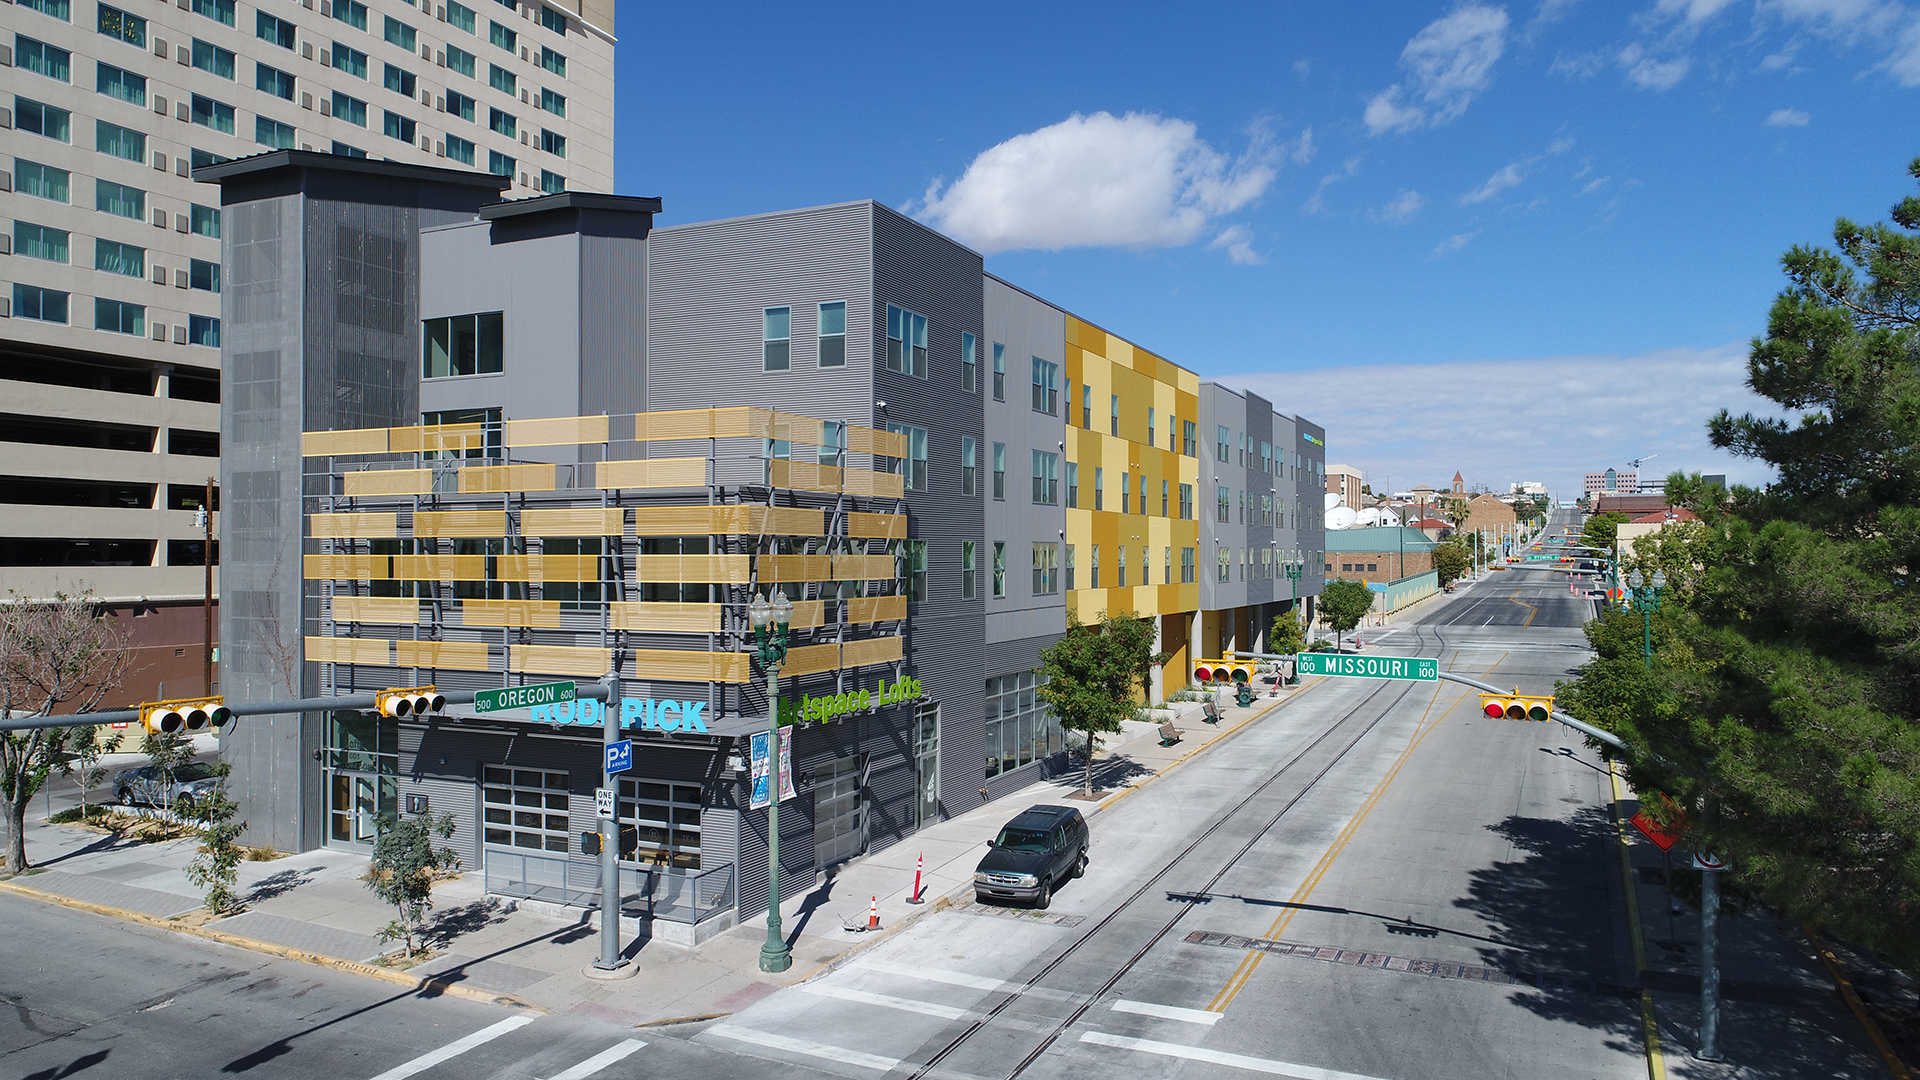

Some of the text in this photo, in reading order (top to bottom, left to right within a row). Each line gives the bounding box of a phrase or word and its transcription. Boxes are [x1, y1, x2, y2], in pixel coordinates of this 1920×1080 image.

[1300, 657, 1408, 677] 100 MISSOURI
[1418, 667, 1435, 678] 100
[476, 686, 574, 711] 500 OREGON 600
[777, 674, 922, 726] Artspace Lofts
[531, 697, 709, 733] RODRICK
[598, 790, 612, 800] ONE
[598, 799, 613, 808] WAY
[681, 834, 695, 844] TEA
